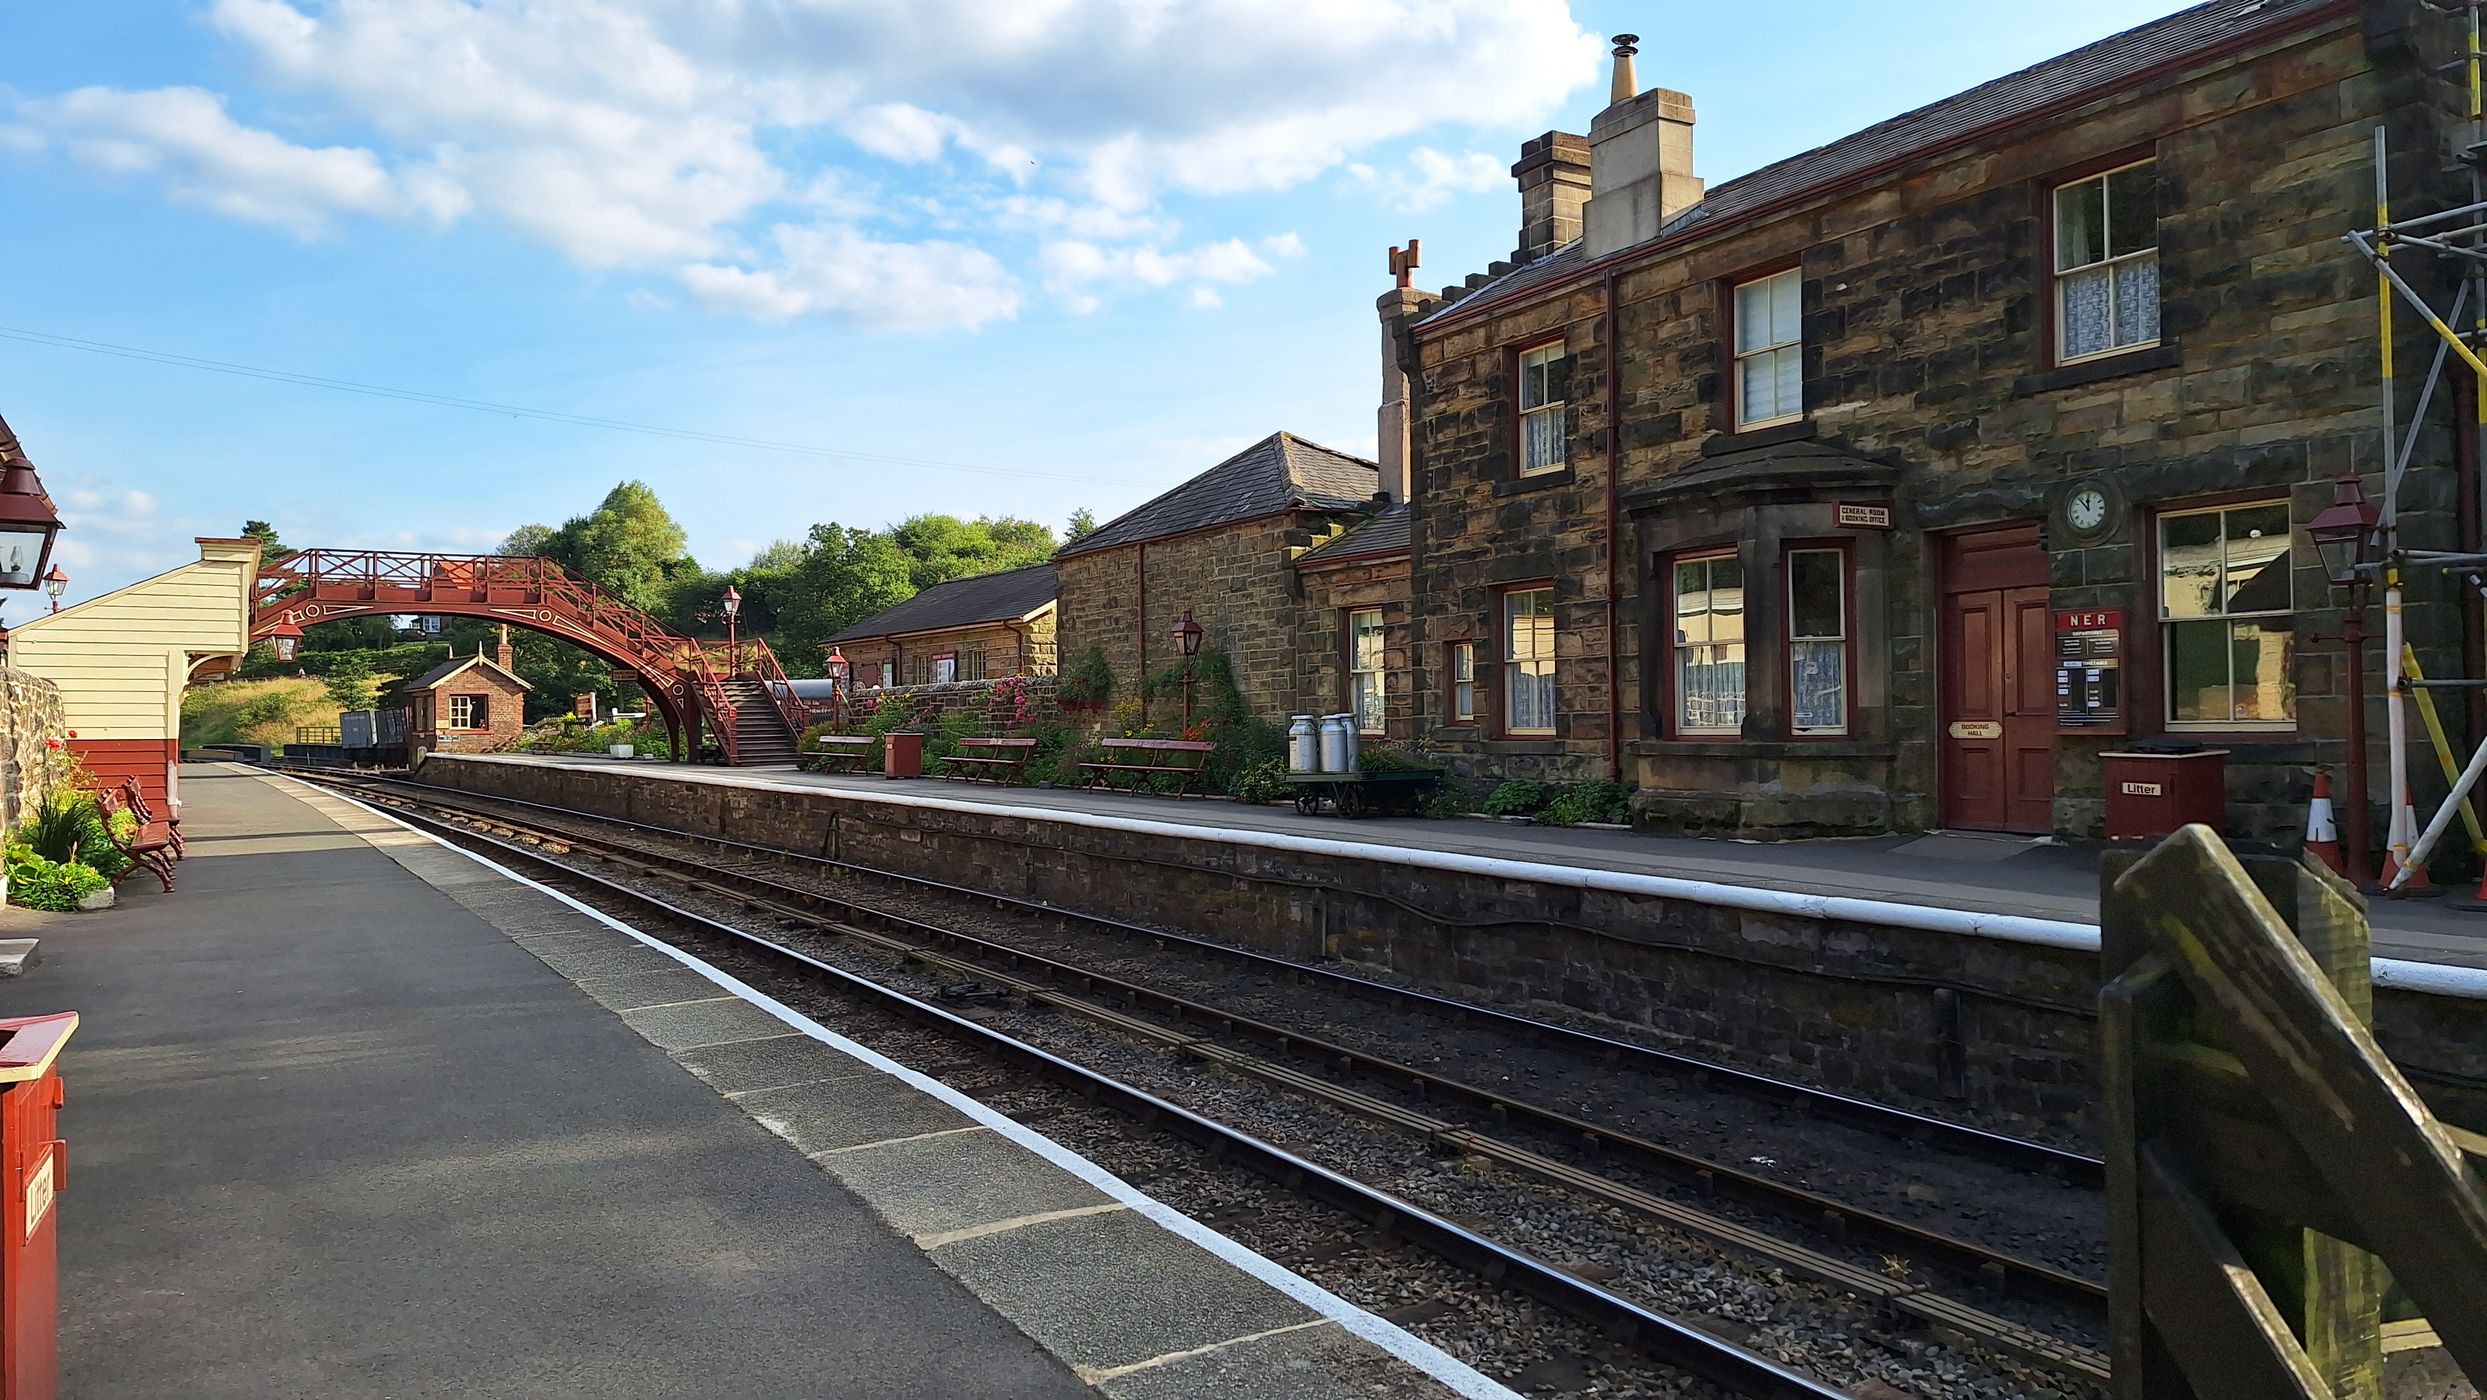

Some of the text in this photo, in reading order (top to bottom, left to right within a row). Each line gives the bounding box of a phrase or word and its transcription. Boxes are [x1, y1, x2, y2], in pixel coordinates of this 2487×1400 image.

[1841, 507, 1867, 515] GENERAL
[1845, 514, 1868, 523] BOOKING
[2127, 783, 2156, 794] Litter
[30, 1171, 50, 1225] Litter
